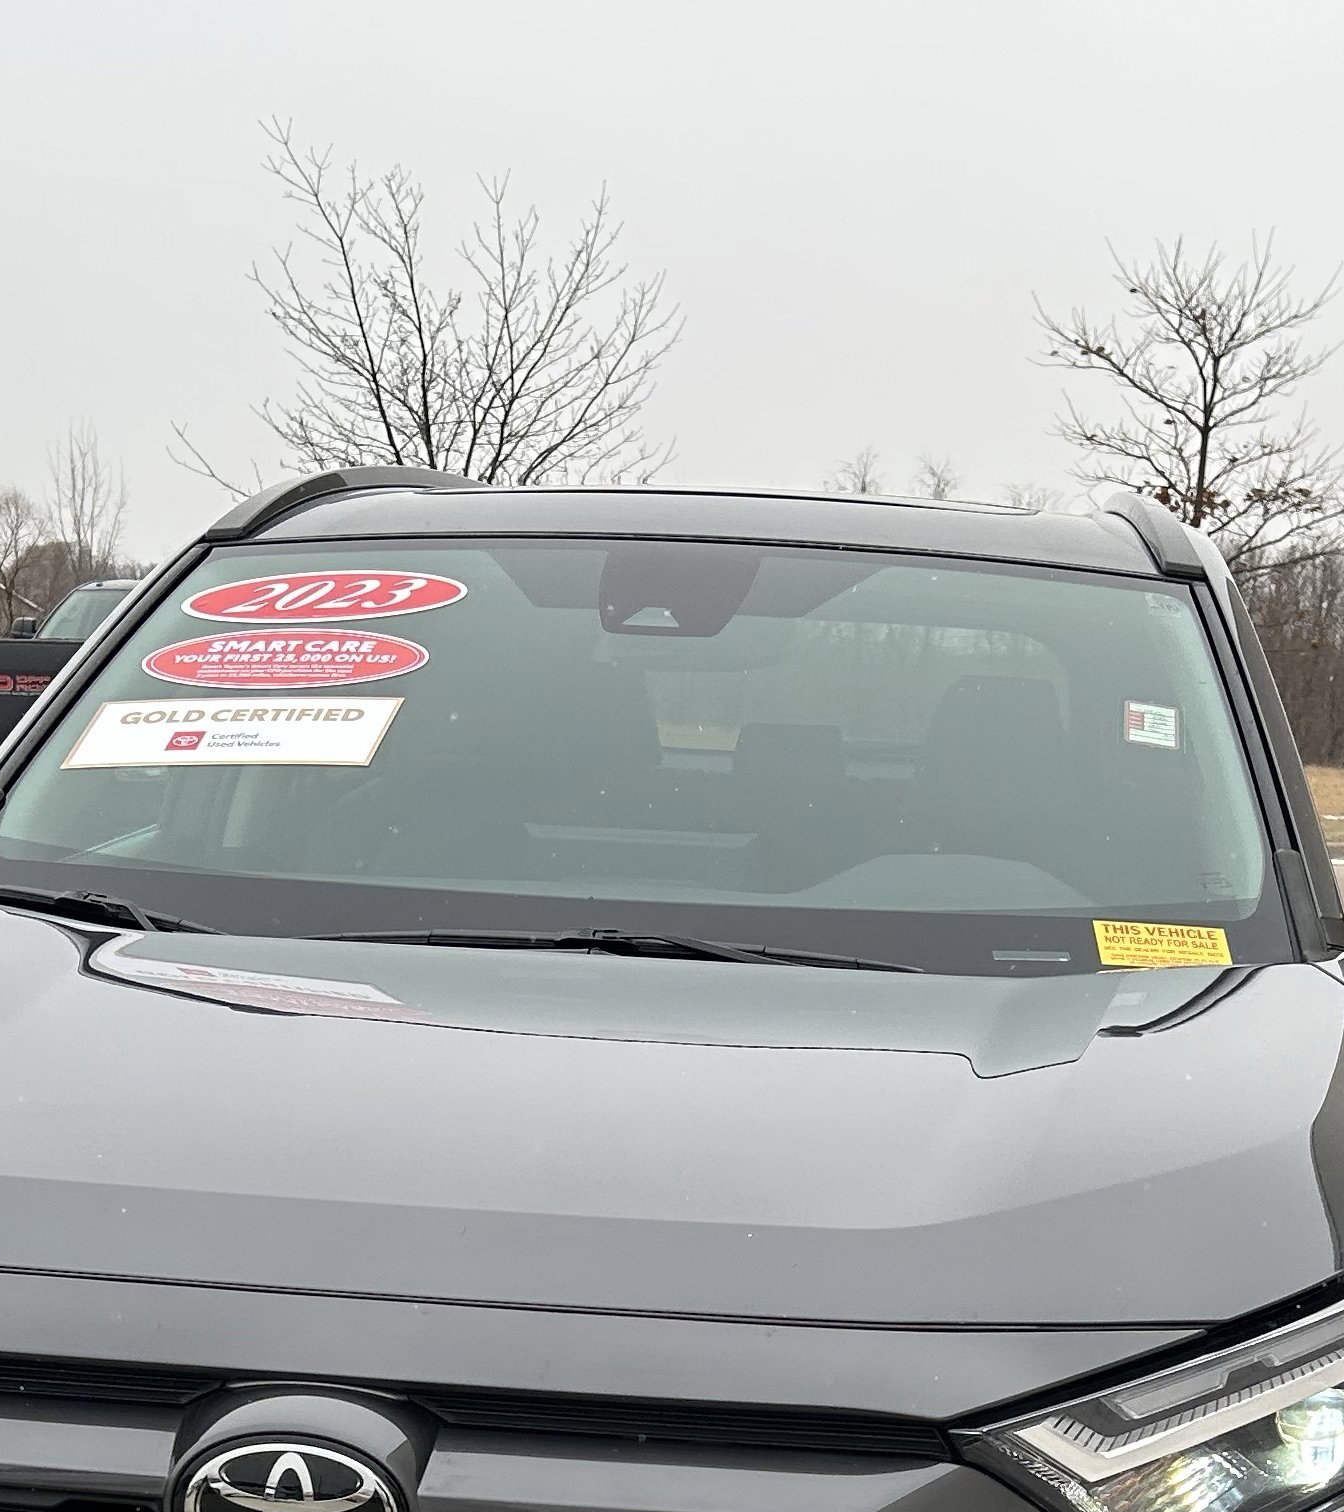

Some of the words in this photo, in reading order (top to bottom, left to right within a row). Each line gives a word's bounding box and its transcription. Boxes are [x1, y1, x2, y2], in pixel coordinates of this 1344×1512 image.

[221, 578, 428, 614] 2023
[207, 640, 304, 653] SMART
[304, 640, 378, 653] CARE
[175, 654, 223, 664] YOUR
[223, 653, 273, 663] FIRST
[273, 653, 333, 664] 25,000
[334, 653, 364, 663] ON
[365, 654, 398, 664] US!
[119, 709, 206, 725] GOLD
[210, 708, 366, 722] CERTIFIED
[211, 732, 260, 740] Certified
[1101, 923, 1141, 936] THIS
[1144, 926, 1219, 941] VEHICLE
[1103, 935, 1126, 945] NOT
[1130, 936, 1165, 947] READY
[1167, 939, 1190, 949] FOR
[1191, 941, 1219, 951] SALE
